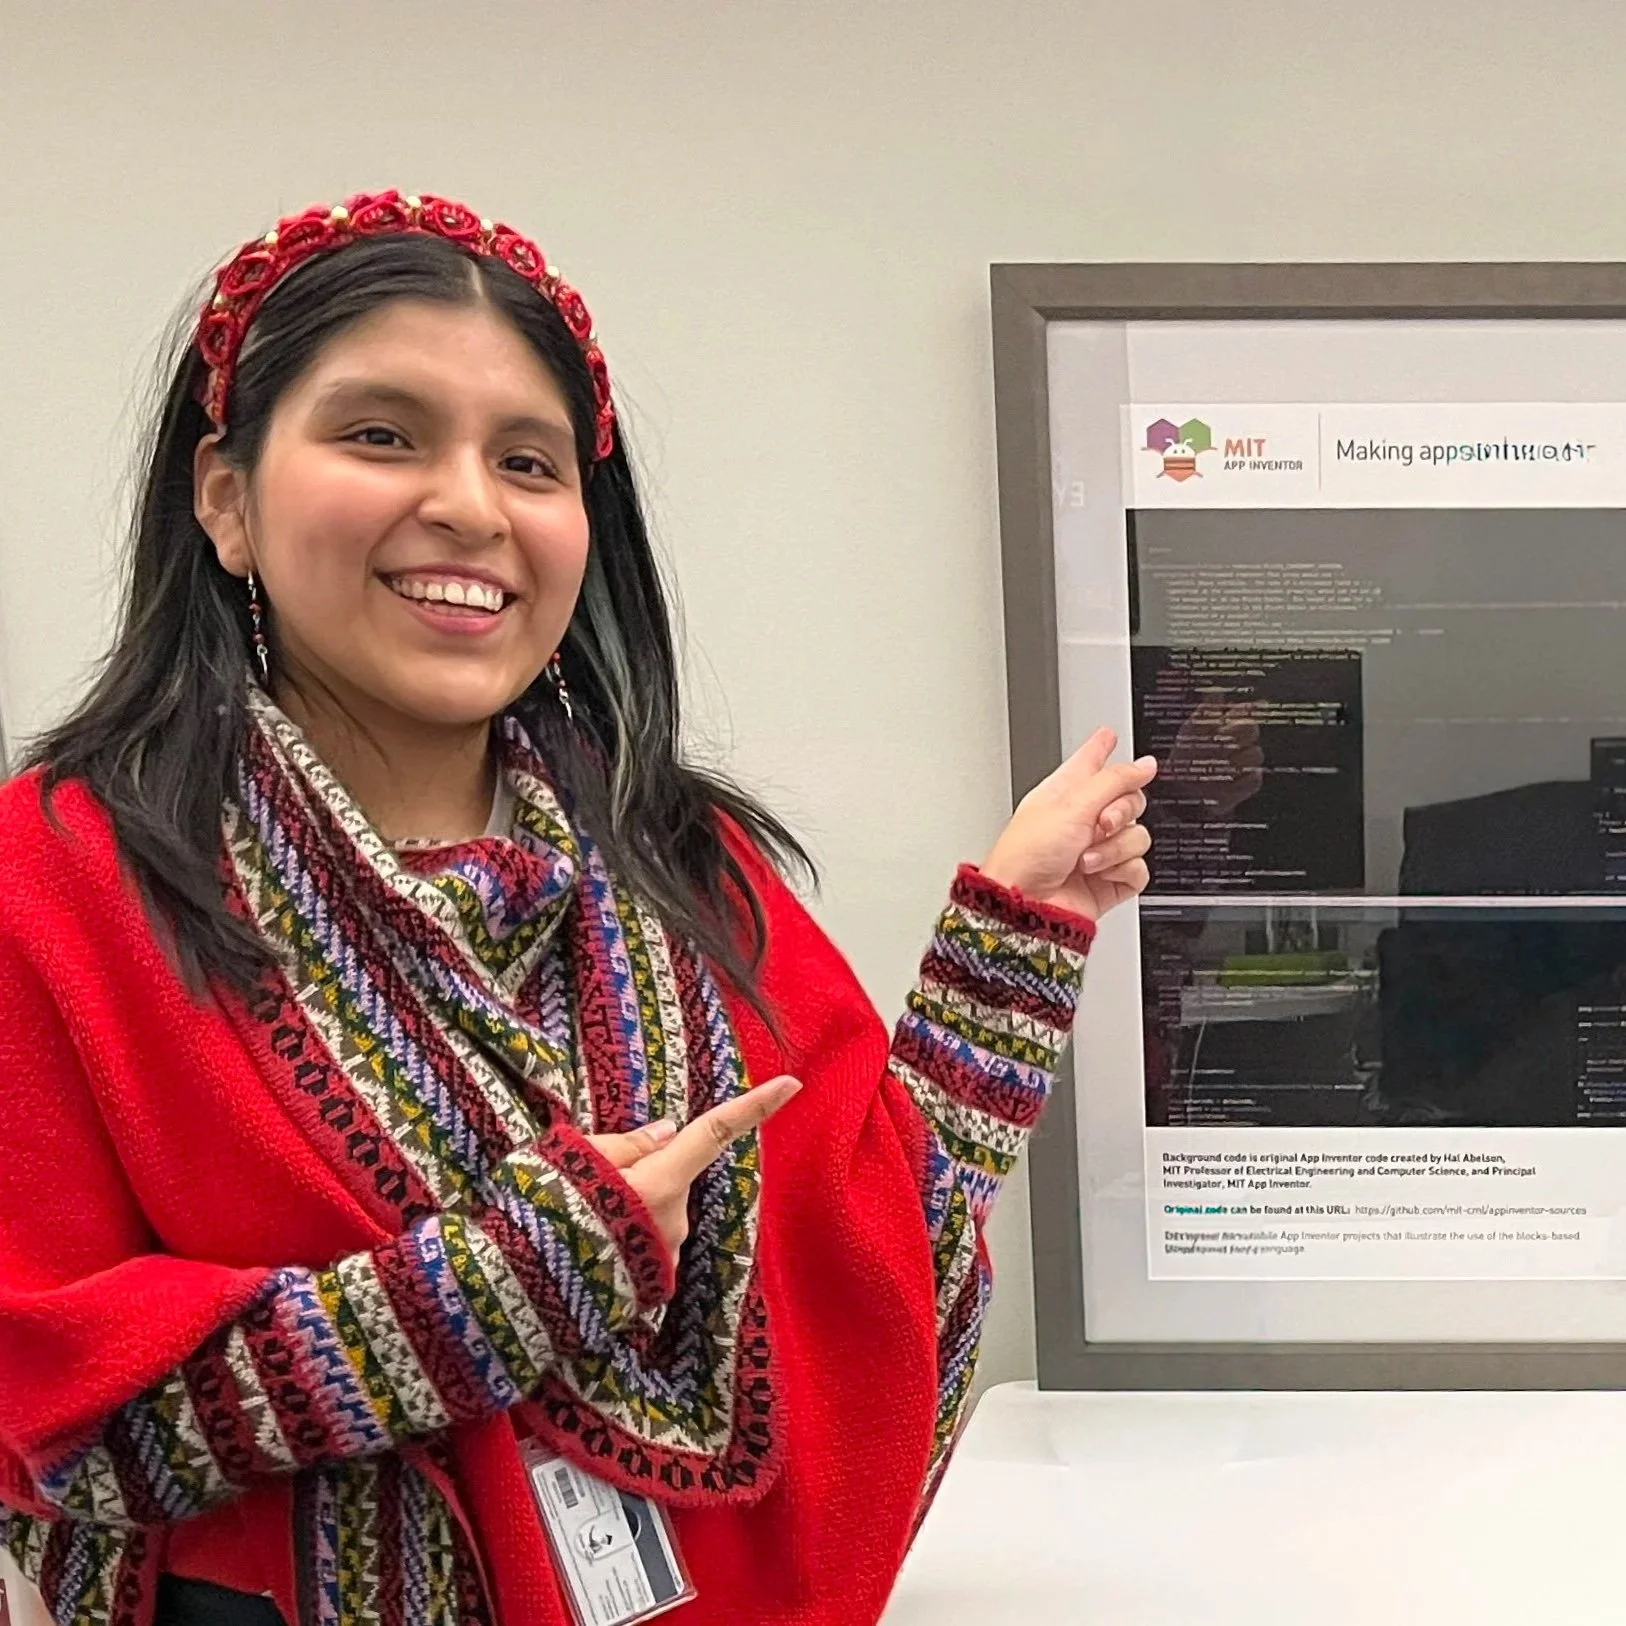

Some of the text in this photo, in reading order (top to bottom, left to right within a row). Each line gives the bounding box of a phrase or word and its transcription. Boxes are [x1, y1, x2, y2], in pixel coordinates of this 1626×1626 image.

[1224, 438, 1267, 458] MIT
[1336, 439, 1414, 467] Making
[1224, 460, 1303, 471] APP INVENTOR
[1163, 1153, 1506, 1165] Background code is original App Inventor code created by Hal Abelson,
[1163, 1165, 1537, 1178] MIT Professor of Electrical Engineering and Computer Science, and Principal
[1163, 1178, 1226, 1190] Investigator,
[1227, 1179, 1246, 1189] MIT
[1248, 1179, 1267, 1190] App
[1230, 1207, 1248, 1215] can
[1250, 1205, 1262, 1215] be
[1264, 1205, 1292, 1215] found
[1294, 1206, 1304, 1215] at
[1306, 1205, 1325, 1215] this
[1280, 1232, 1299, 1242] App
[1301, 1232, 1340, 1240] Inventor
[1343, 1232, 1381, 1243] projects
[1383, 1232, 1402, 1240] that
[1450, 1232, 1465, 1240] the
[1486, 1232, 1496, 1240] of
[1498, 1232, 1514, 1240] the
[1516, 1232, 1580, 1241] blocks-based
